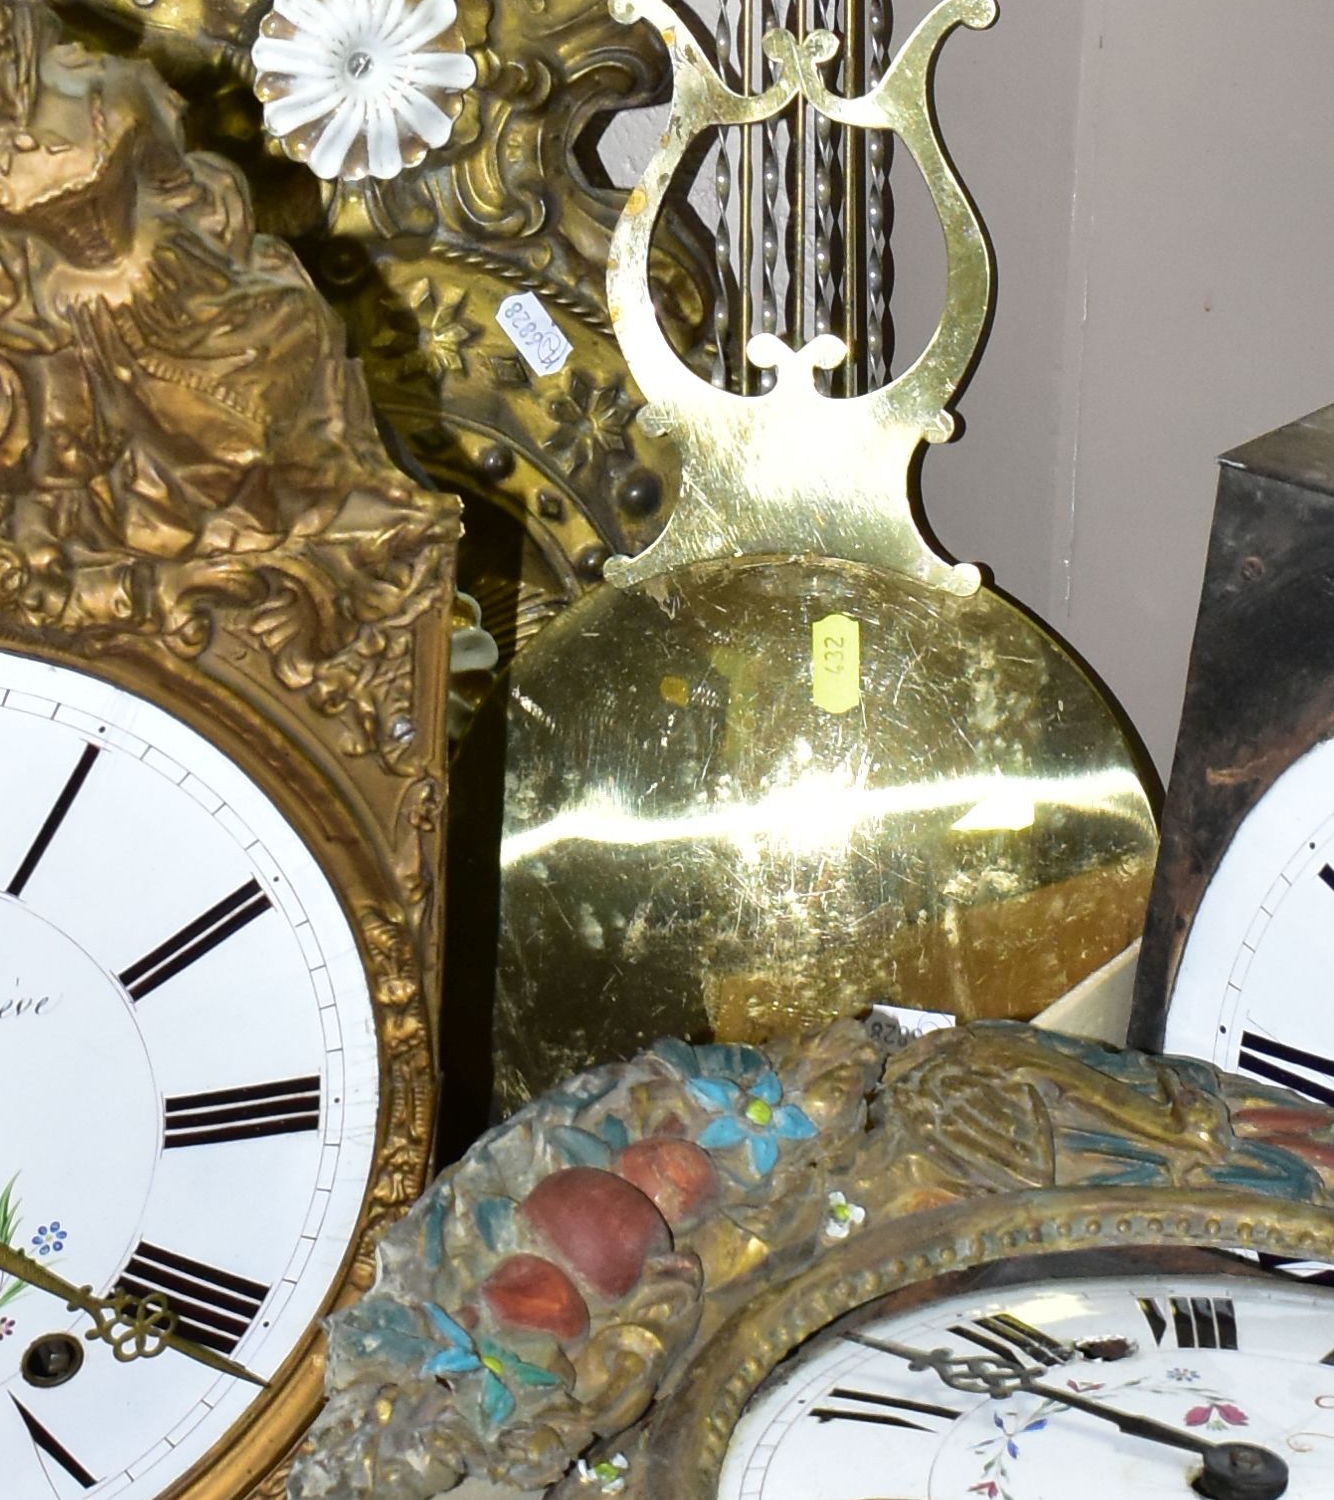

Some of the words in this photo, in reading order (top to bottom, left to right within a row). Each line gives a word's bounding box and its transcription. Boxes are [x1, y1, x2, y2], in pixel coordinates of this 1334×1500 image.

[824, 637, 844, 674] 432
[117, 876, 275, 1003] II
[161, 1073, 322, 1151] III
